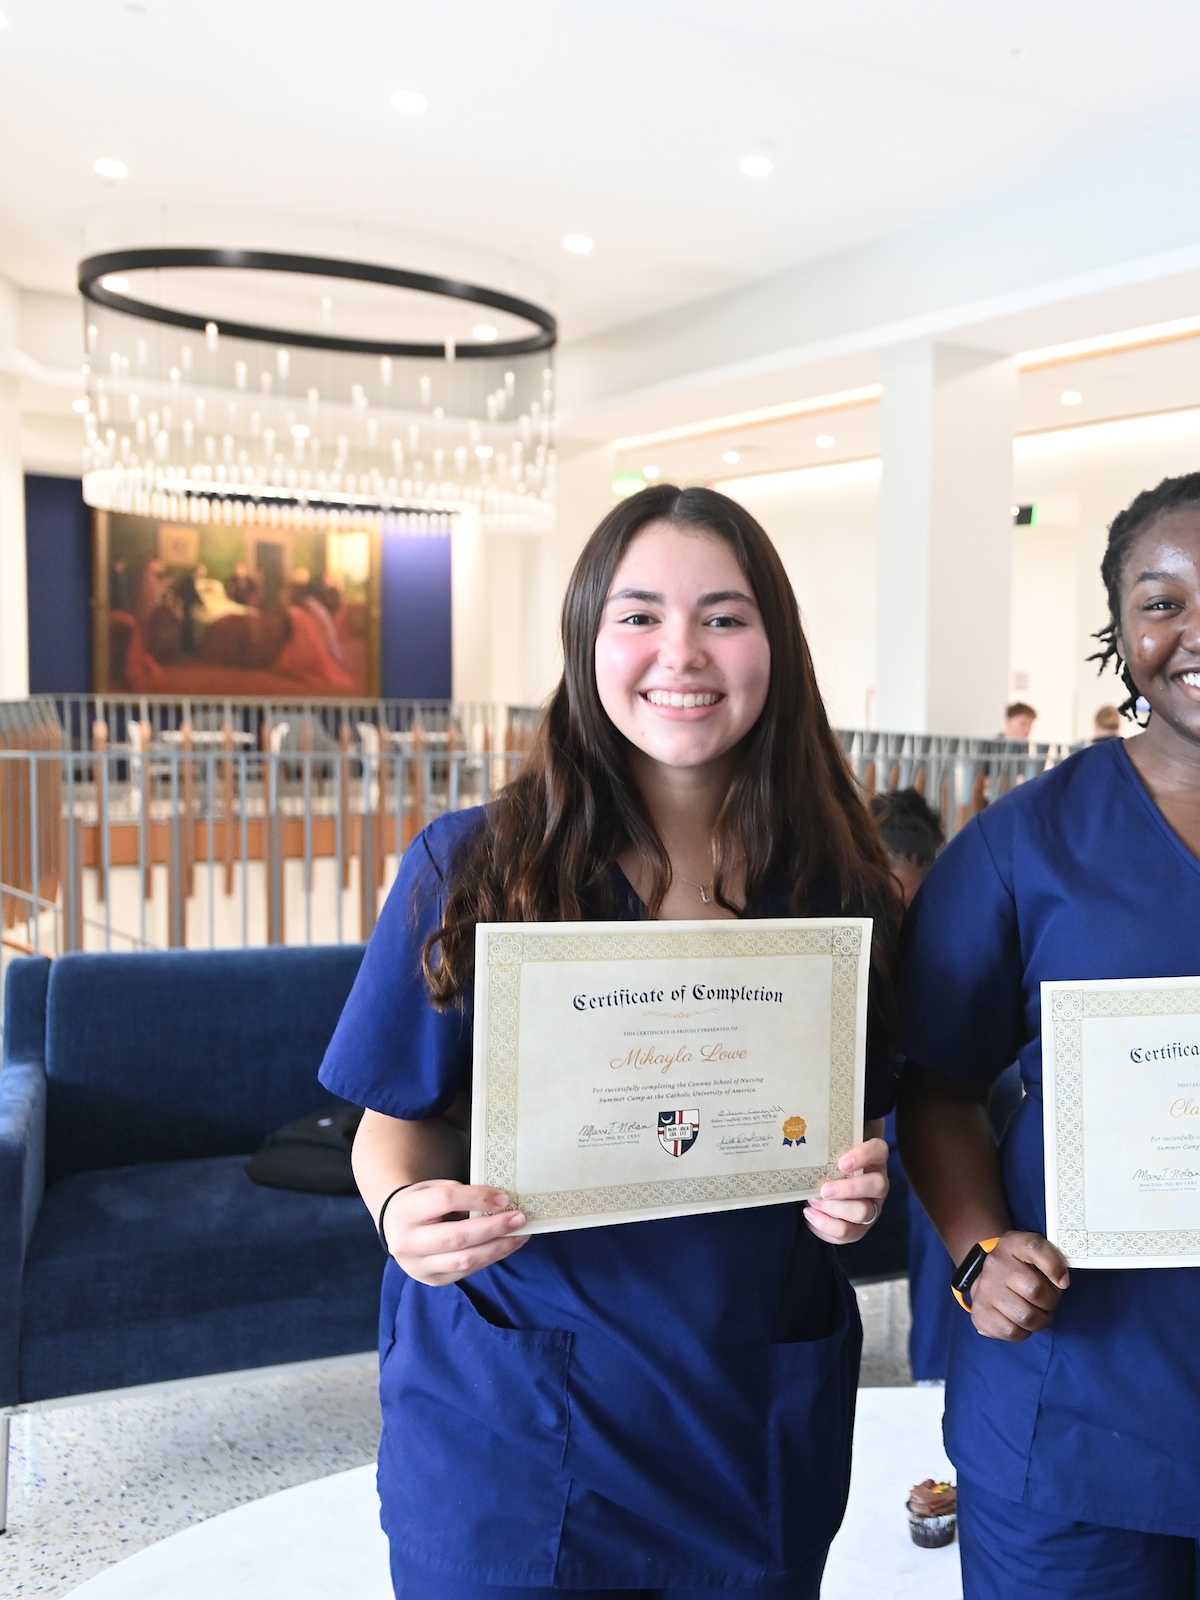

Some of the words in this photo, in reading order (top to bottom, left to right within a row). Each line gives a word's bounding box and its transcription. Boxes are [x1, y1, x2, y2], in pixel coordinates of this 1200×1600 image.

[573, 989, 664, 1011] Certificate
[671, 985, 687, 1003] of
[692, 984, 783, 1003] Completion
[609, 1045, 693, 1074] Mikayla
[700, 1043, 748, 1063] Lowe
[604, 1084, 641, 1093] successfully
[641, 1083, 676, 1091] completing
[713, 1078, 733, 1086] School
[626, 1095, 646, 1103] Camp
[665, 1091, 691, 1099] Catholic
[692, 1089, 724, 1097] University
[786, 1124, 803, 1132] 2025
[1162, 1134, 1196, 1142] successfully
